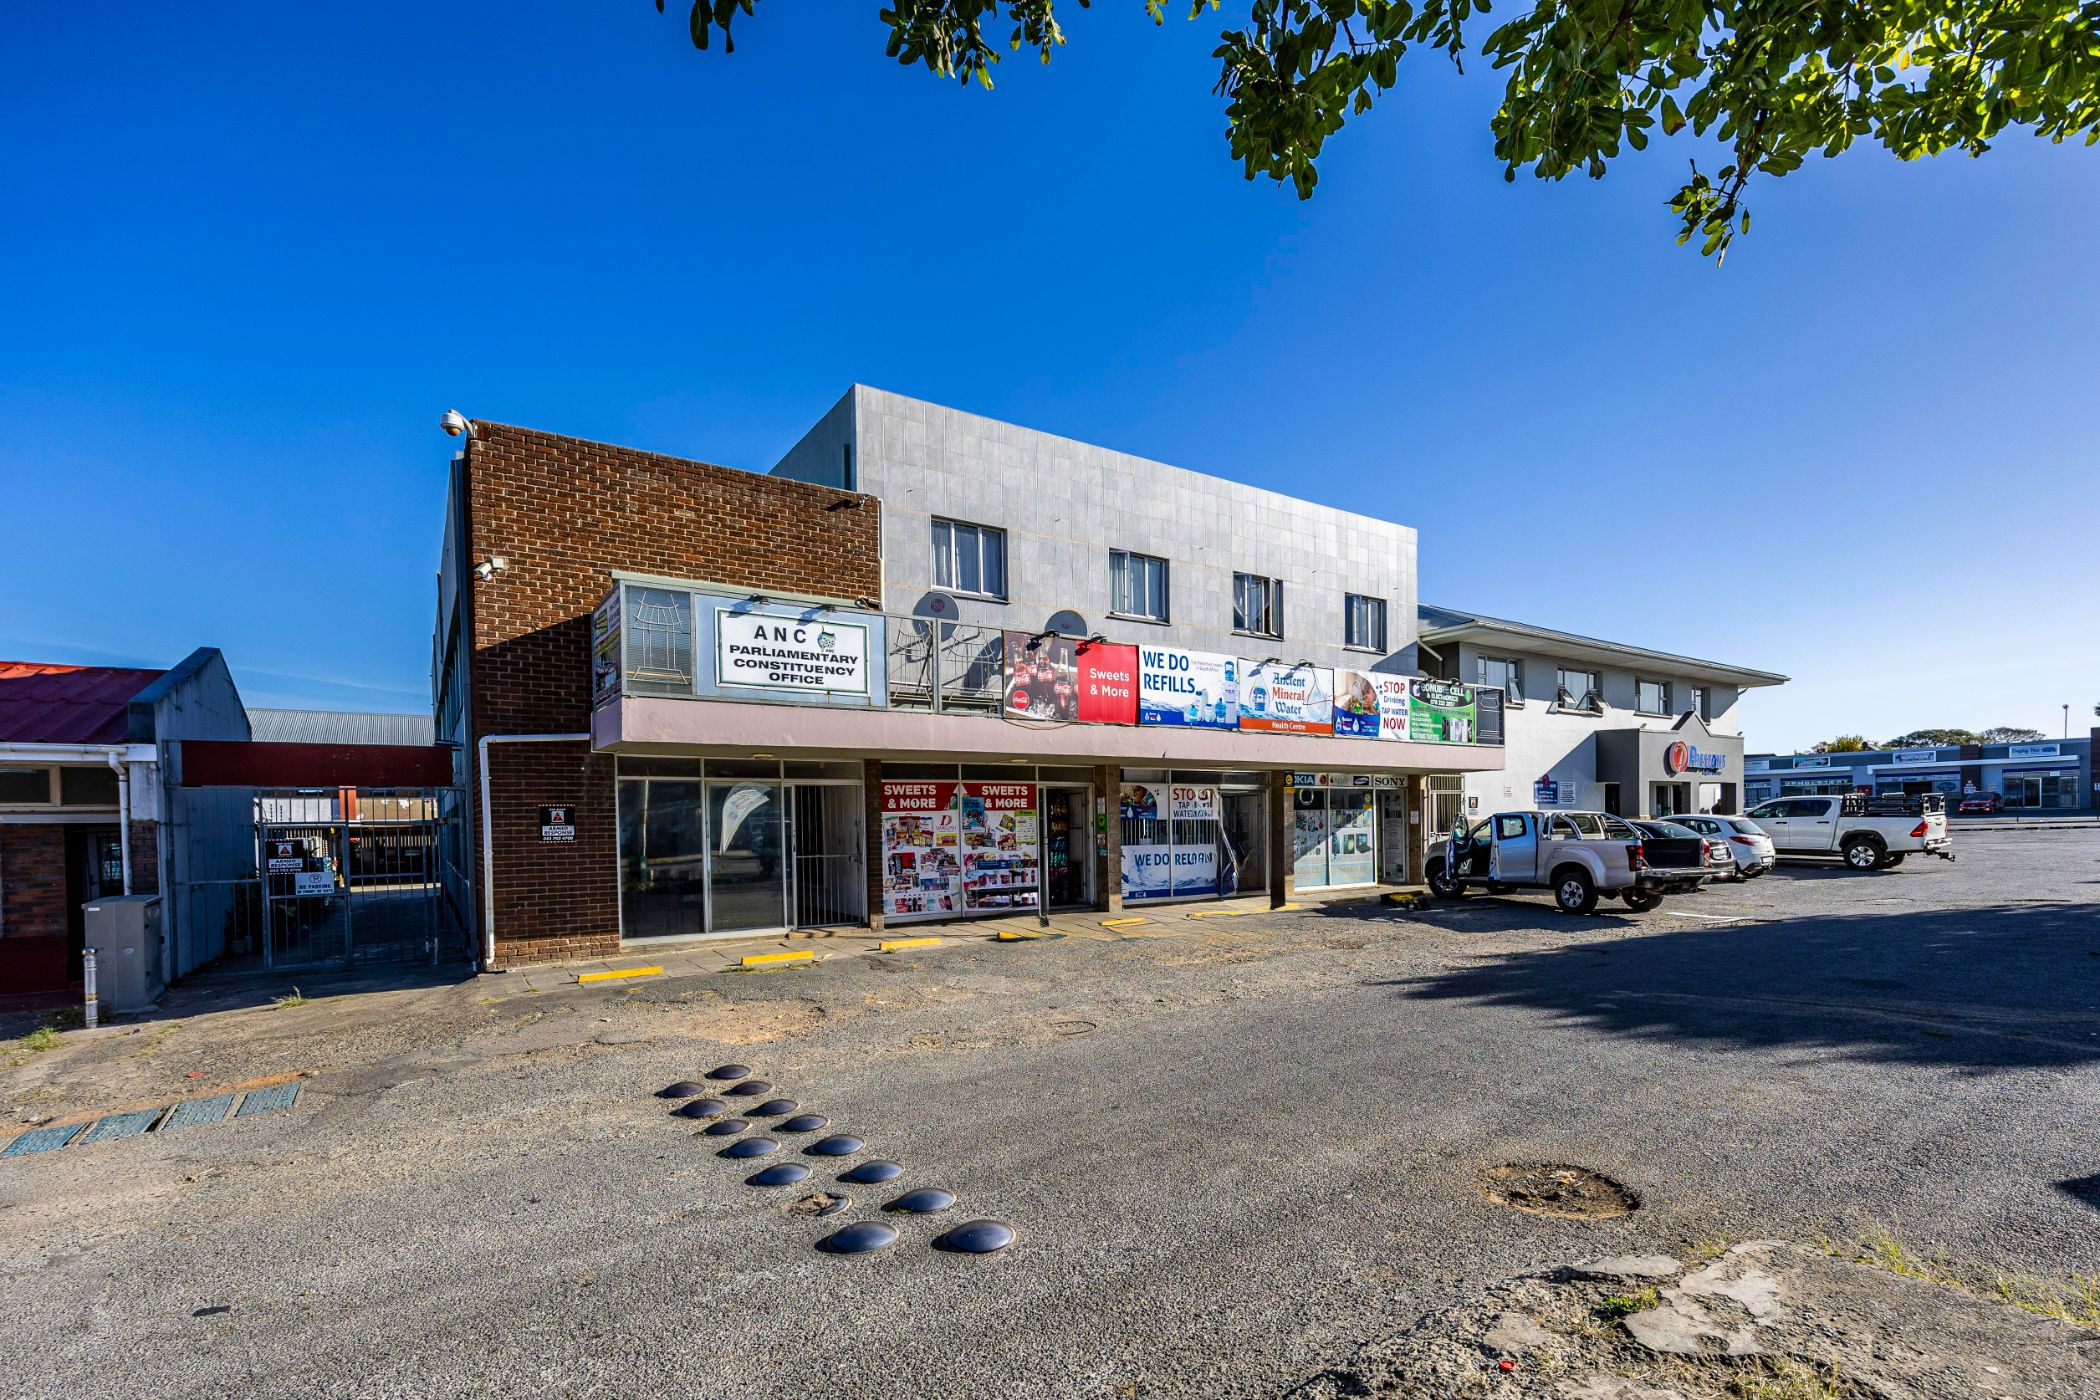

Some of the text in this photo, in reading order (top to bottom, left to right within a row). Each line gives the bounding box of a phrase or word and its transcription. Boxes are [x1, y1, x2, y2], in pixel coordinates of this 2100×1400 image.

[730, 645, 858, 664] PARLIAMENTARY
[1143, 650, 1189, 671] WE DO
[734, 659, 855, 676] CONSTITUENCY
[769, 672, 824, 685] OFFICE
[1089, 668, 1130, 682] Sweets
[1272, 672, 1306, 687] Ancient
[1143, 672, 1196, 694] REFILLS
[1383, 681, 1406, 694] STOP
[1090, 685, 1129, 697] & More
[1272, 687, 1305, 701] Mineral
[1450, 686, 1465, 697] CELL
[1383, 696, 1406, 706] Drinking
[1275, 702, 1302, 715] Water
[1381, 707, 1391, 715] TAP
[1391, 708, 1408, 716] WATER
[1272, 722, 1288, 730] Health
[1383, 717, 1406, 730] NOW
[1295, 775, 1315, 784] KIA
[1374, 777, 1406, 786] SONY
[884, 784, 937, 796] SWEETS
[981, 785, 1028, 796] SWEETS
[887, 798, 937, 809] & MORE
[984, 798, 993, 808] &
[995, 798, 1028, 808] MORE
[1178, 801, 1190, 809] TAP
[1134, 853, 1151, 866] WE
[1154, 853, 1170, 866] DO
